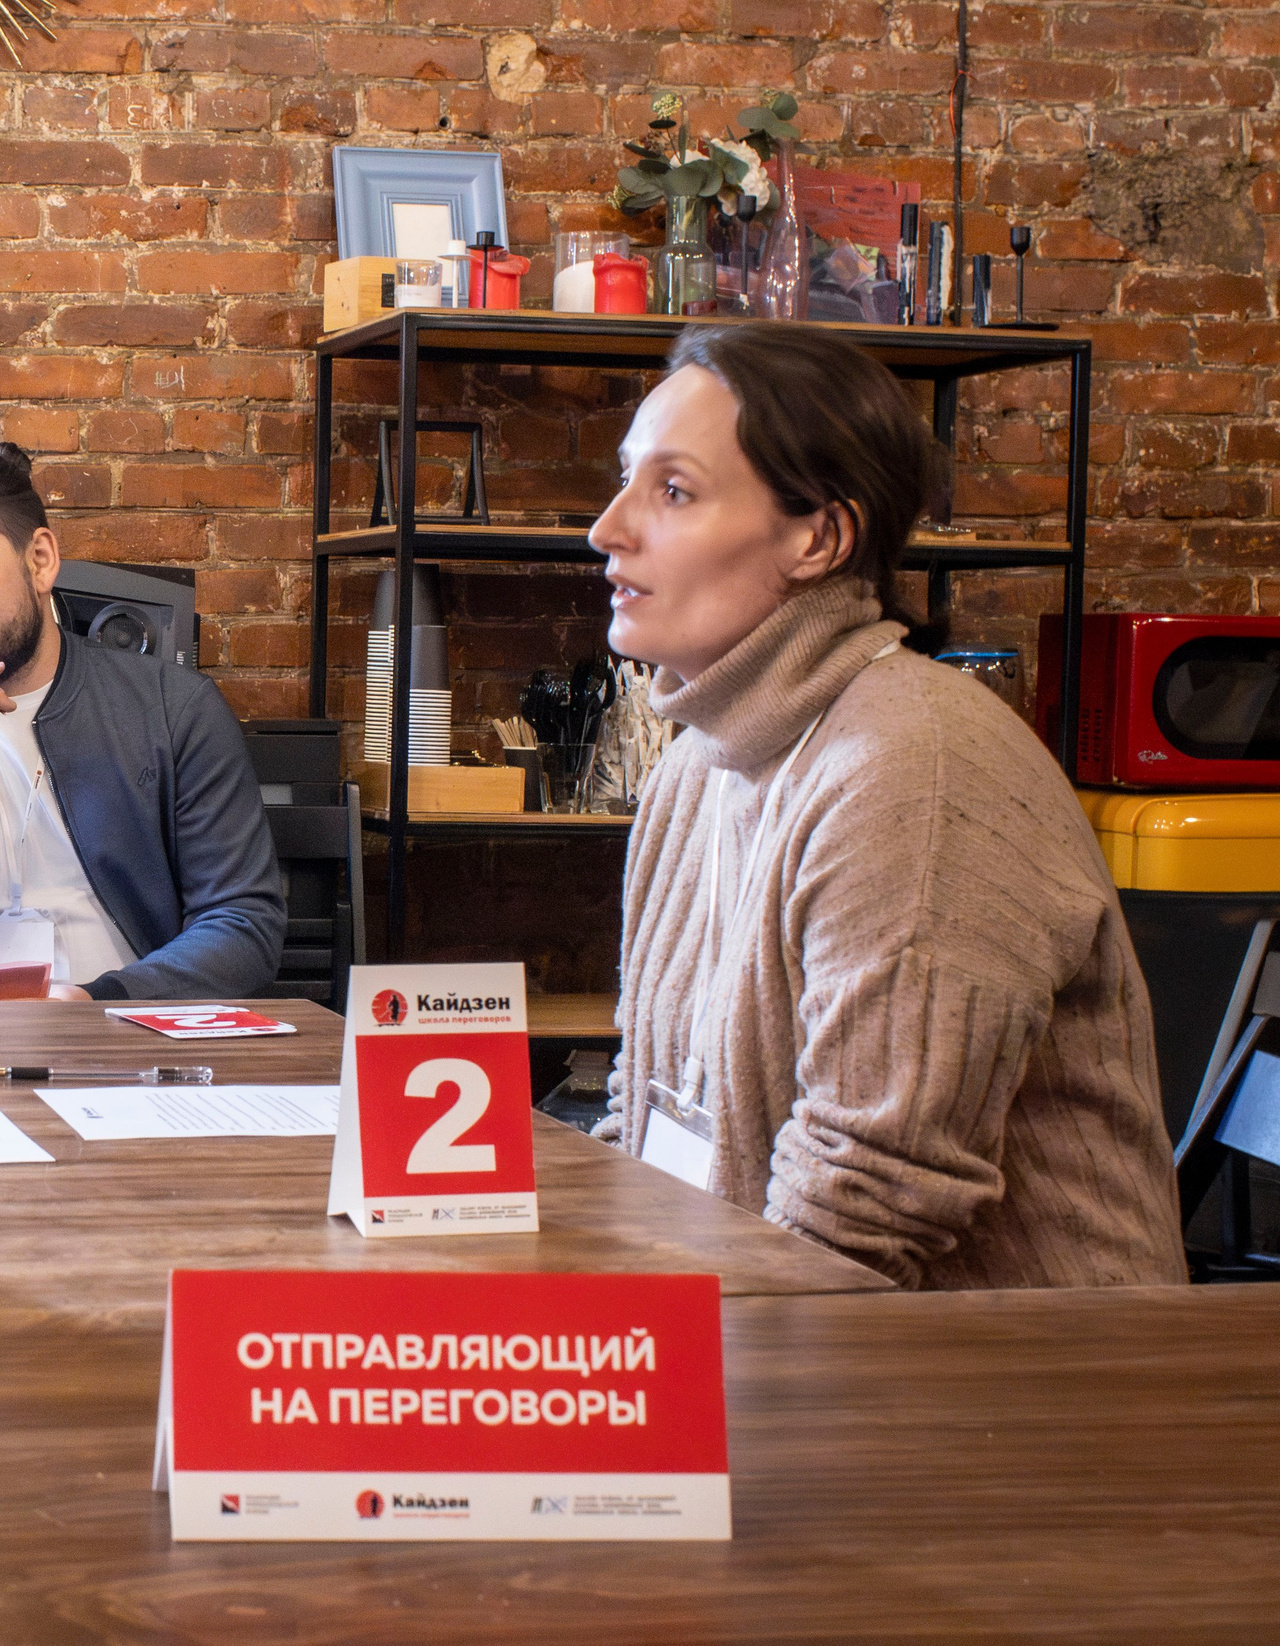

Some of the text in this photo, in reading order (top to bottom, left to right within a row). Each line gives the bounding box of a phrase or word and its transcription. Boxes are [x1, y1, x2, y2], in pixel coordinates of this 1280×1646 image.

[417, 992, 510, 1013] Кайдзен
[452, 1016, 511, 1025] переговоров
[404, 1058, 497, 1174] 2
[237, 1328, 656, 1377] ОТПРАВЛЯЮЩИЙ
[251, 1387, 647, 1426] НА ПЕРЕГОВОРЫ
[392, 1493, 470, 1510] Кайдзен
